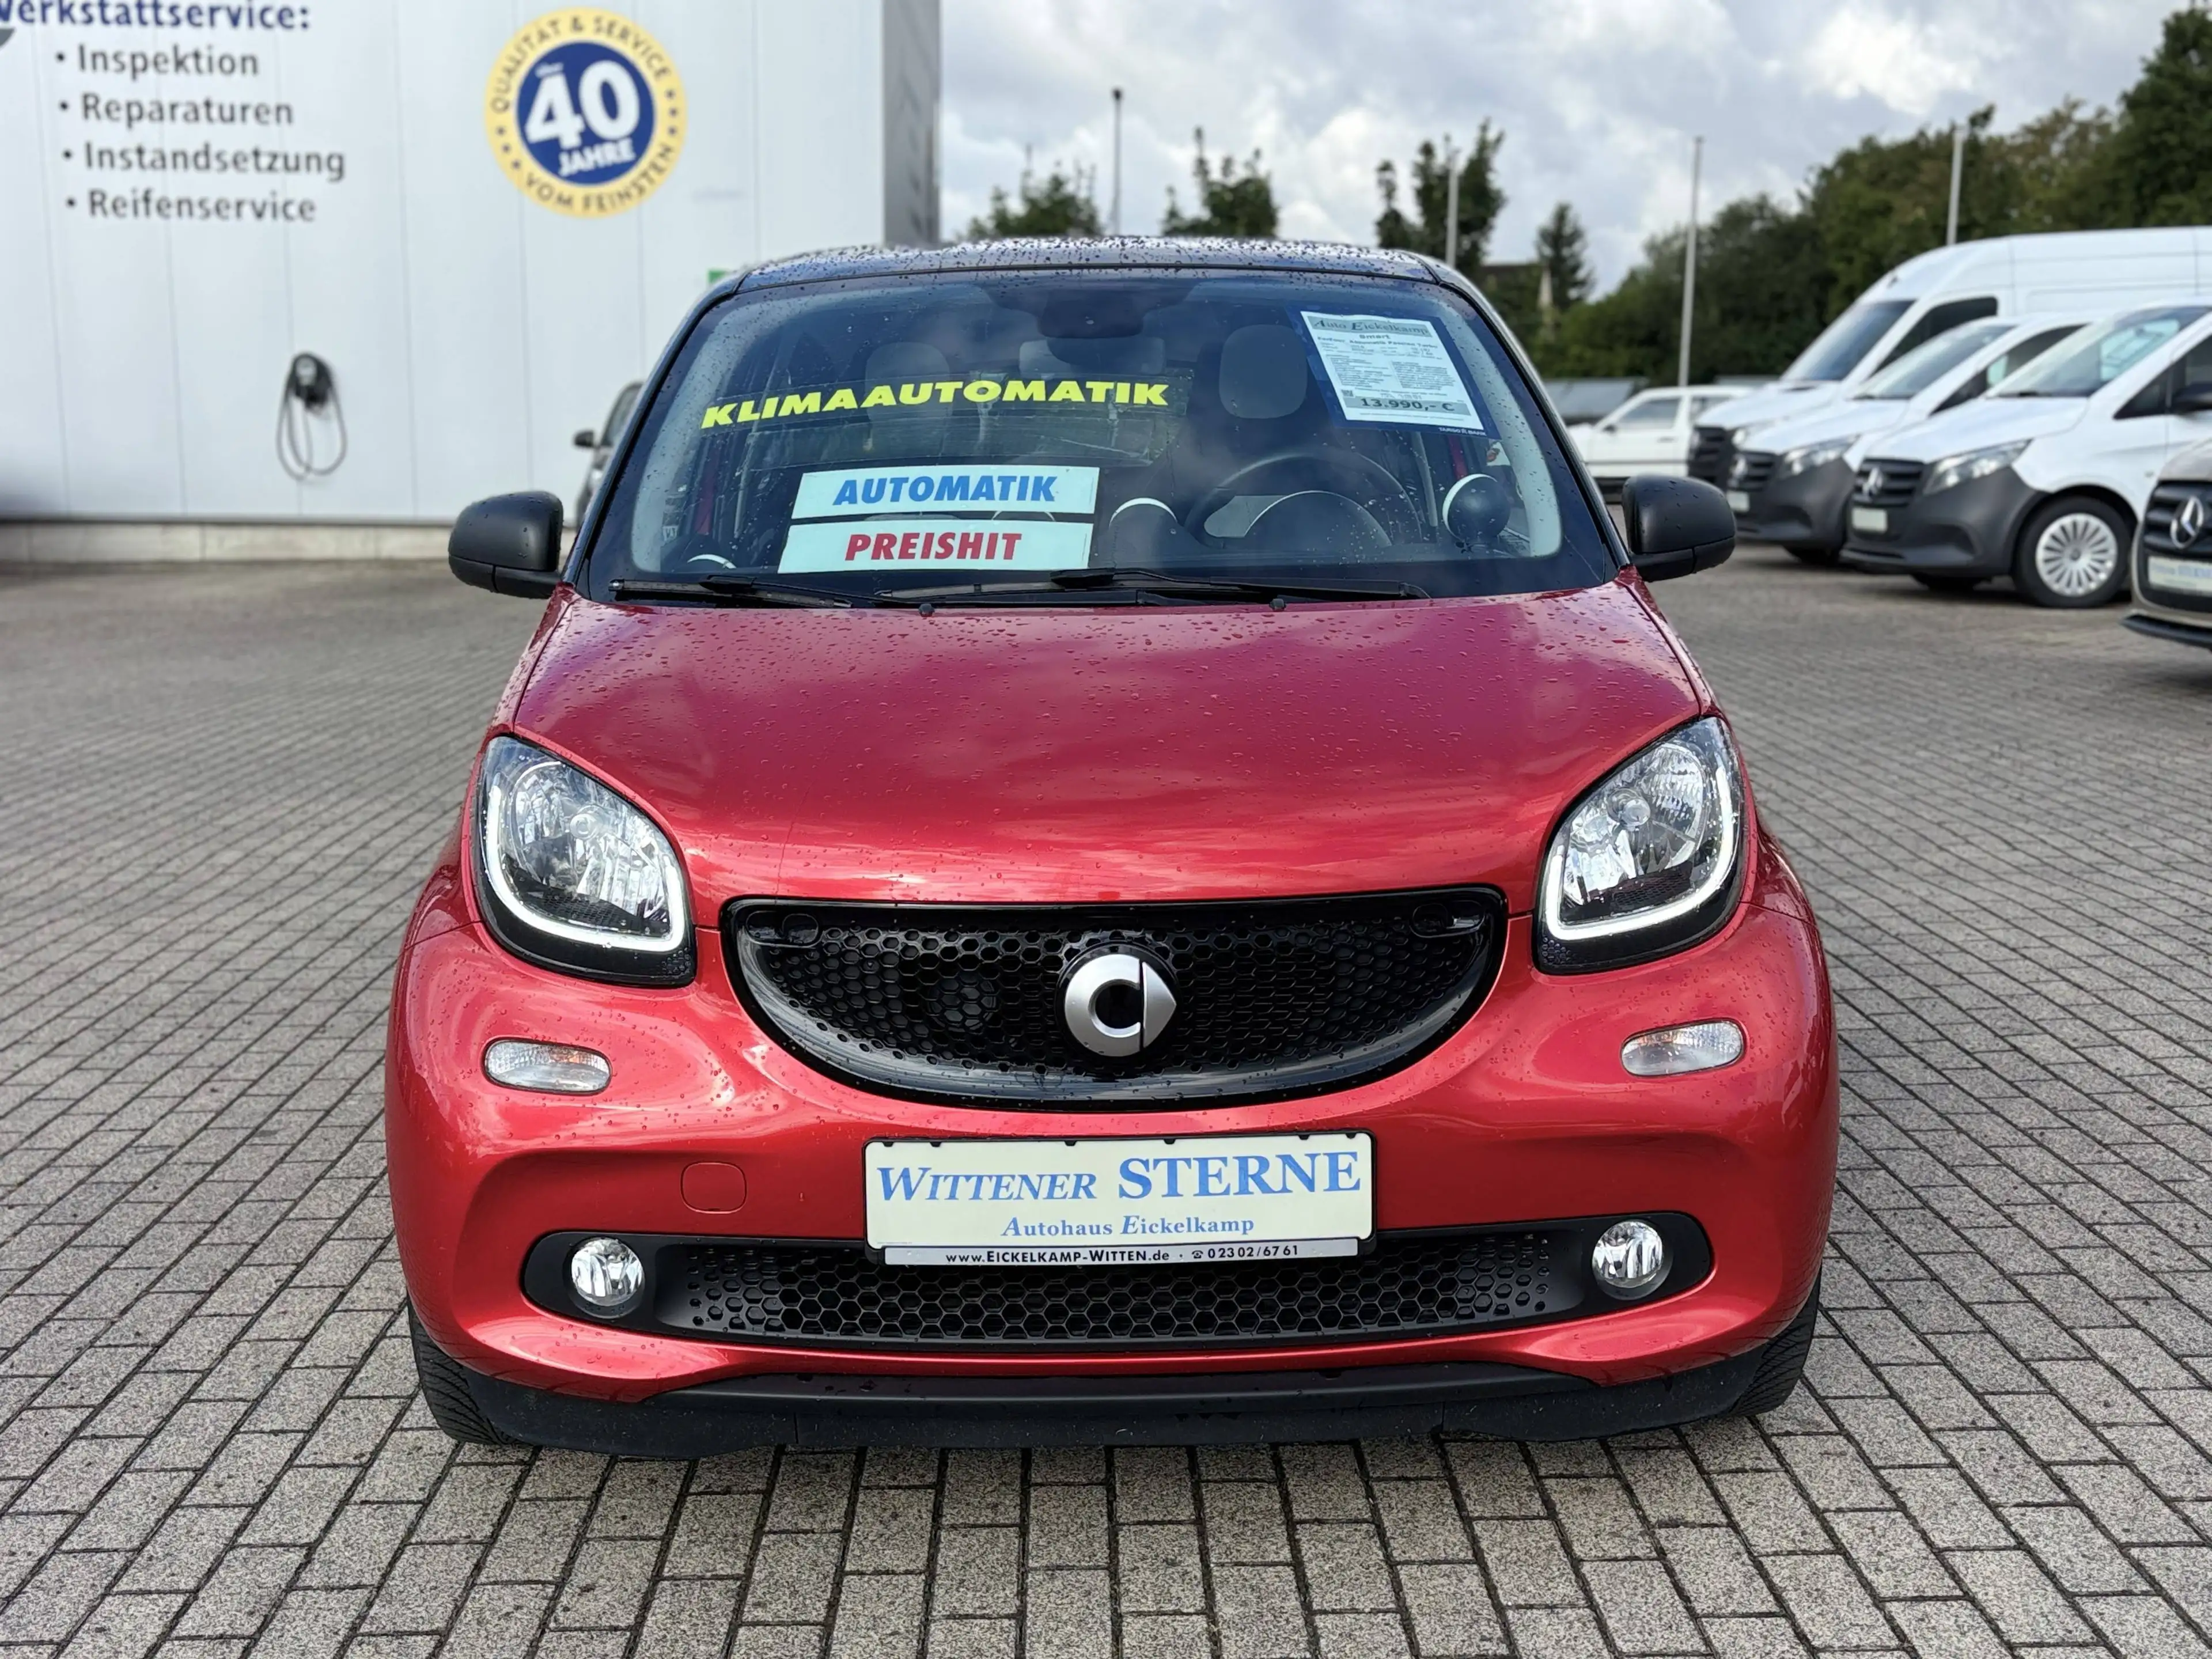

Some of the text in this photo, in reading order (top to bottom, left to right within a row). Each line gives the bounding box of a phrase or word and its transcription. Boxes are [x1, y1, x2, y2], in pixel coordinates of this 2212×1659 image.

[78, 44, 259, 80] Inspektion
[593, 16, 670, 79] SERVICE
[81, 93, 294, 128] Reparaturen
[524, 59, 640, 150] 40
[85, 142, 346, 183] Instandsetzung
[558, 138, 637, 177] JAHRE
[88, 188, 317, 221] Reifenservice
[1314, 319, 1429, 335] Auto Eickelkamp
[700, 380, 1169, 429] KLIMAAUTOMATIK
[833, 475, 1058, 506] AUTOMATIK
[845, 532, 1022, 560] PREISHIT
[877, 1152, 1361, 1201] WITTENER STERNE
[1000, 1215, 1255, 1237] Autohaus Eickelkamp
